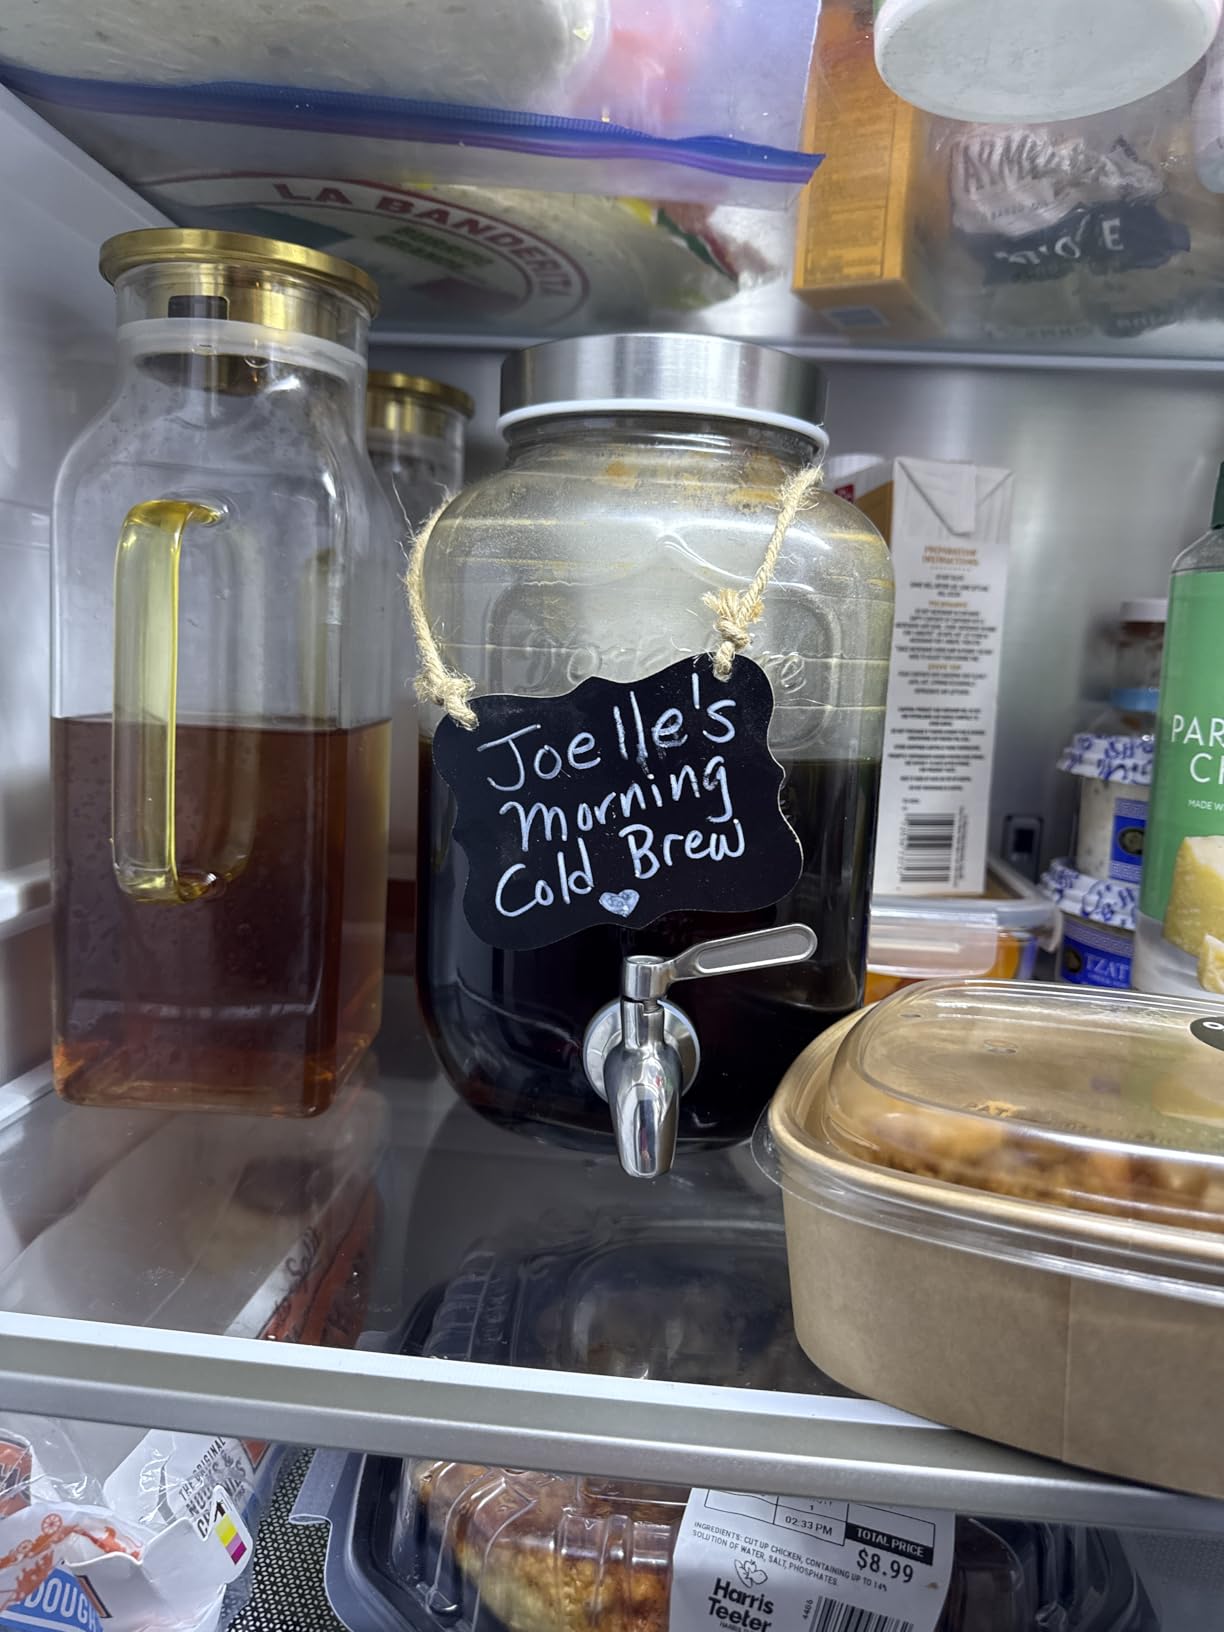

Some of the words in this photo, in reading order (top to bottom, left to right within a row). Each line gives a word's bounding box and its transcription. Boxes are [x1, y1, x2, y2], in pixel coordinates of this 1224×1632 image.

[273, 183, 352, 205] LA
[1189, 752, 1224, 785] C
[1187, 800, 1212, 811] MADE
[495, 837, 594, 917] Cold
[618, 818, 746, 880] Brew
[815, 1522, 833, 1536] PM
[856, 1528, 890, 1547] TOTAL
[891, 1540, 924, 1558] PRICE
[692, 1529, 727, 1547] SOLUTION
[729, 1541, 740, 1551] OF
[740, 1544, 766, 1562] WATER,
[768, 1555, 788, 1570] SALT,
[694, 1521, 742, 1541] INGREDIENTS:
[743, 1536, 759, 1547] CUT
[760, 1541, 769, 1550] UP
[770, 1545, 803, 1564] CHICKEN,
[805, 1558, 850, 1579] CONTAINING
[851, 1572, 861, 1582] UP
[863, 1577, 872, 1586] TO
[856, 1547, 914, 1583] $8.99
[708, 1596, 772, 1632] Teeter
[713, 1577, 774, 1615] Harris
